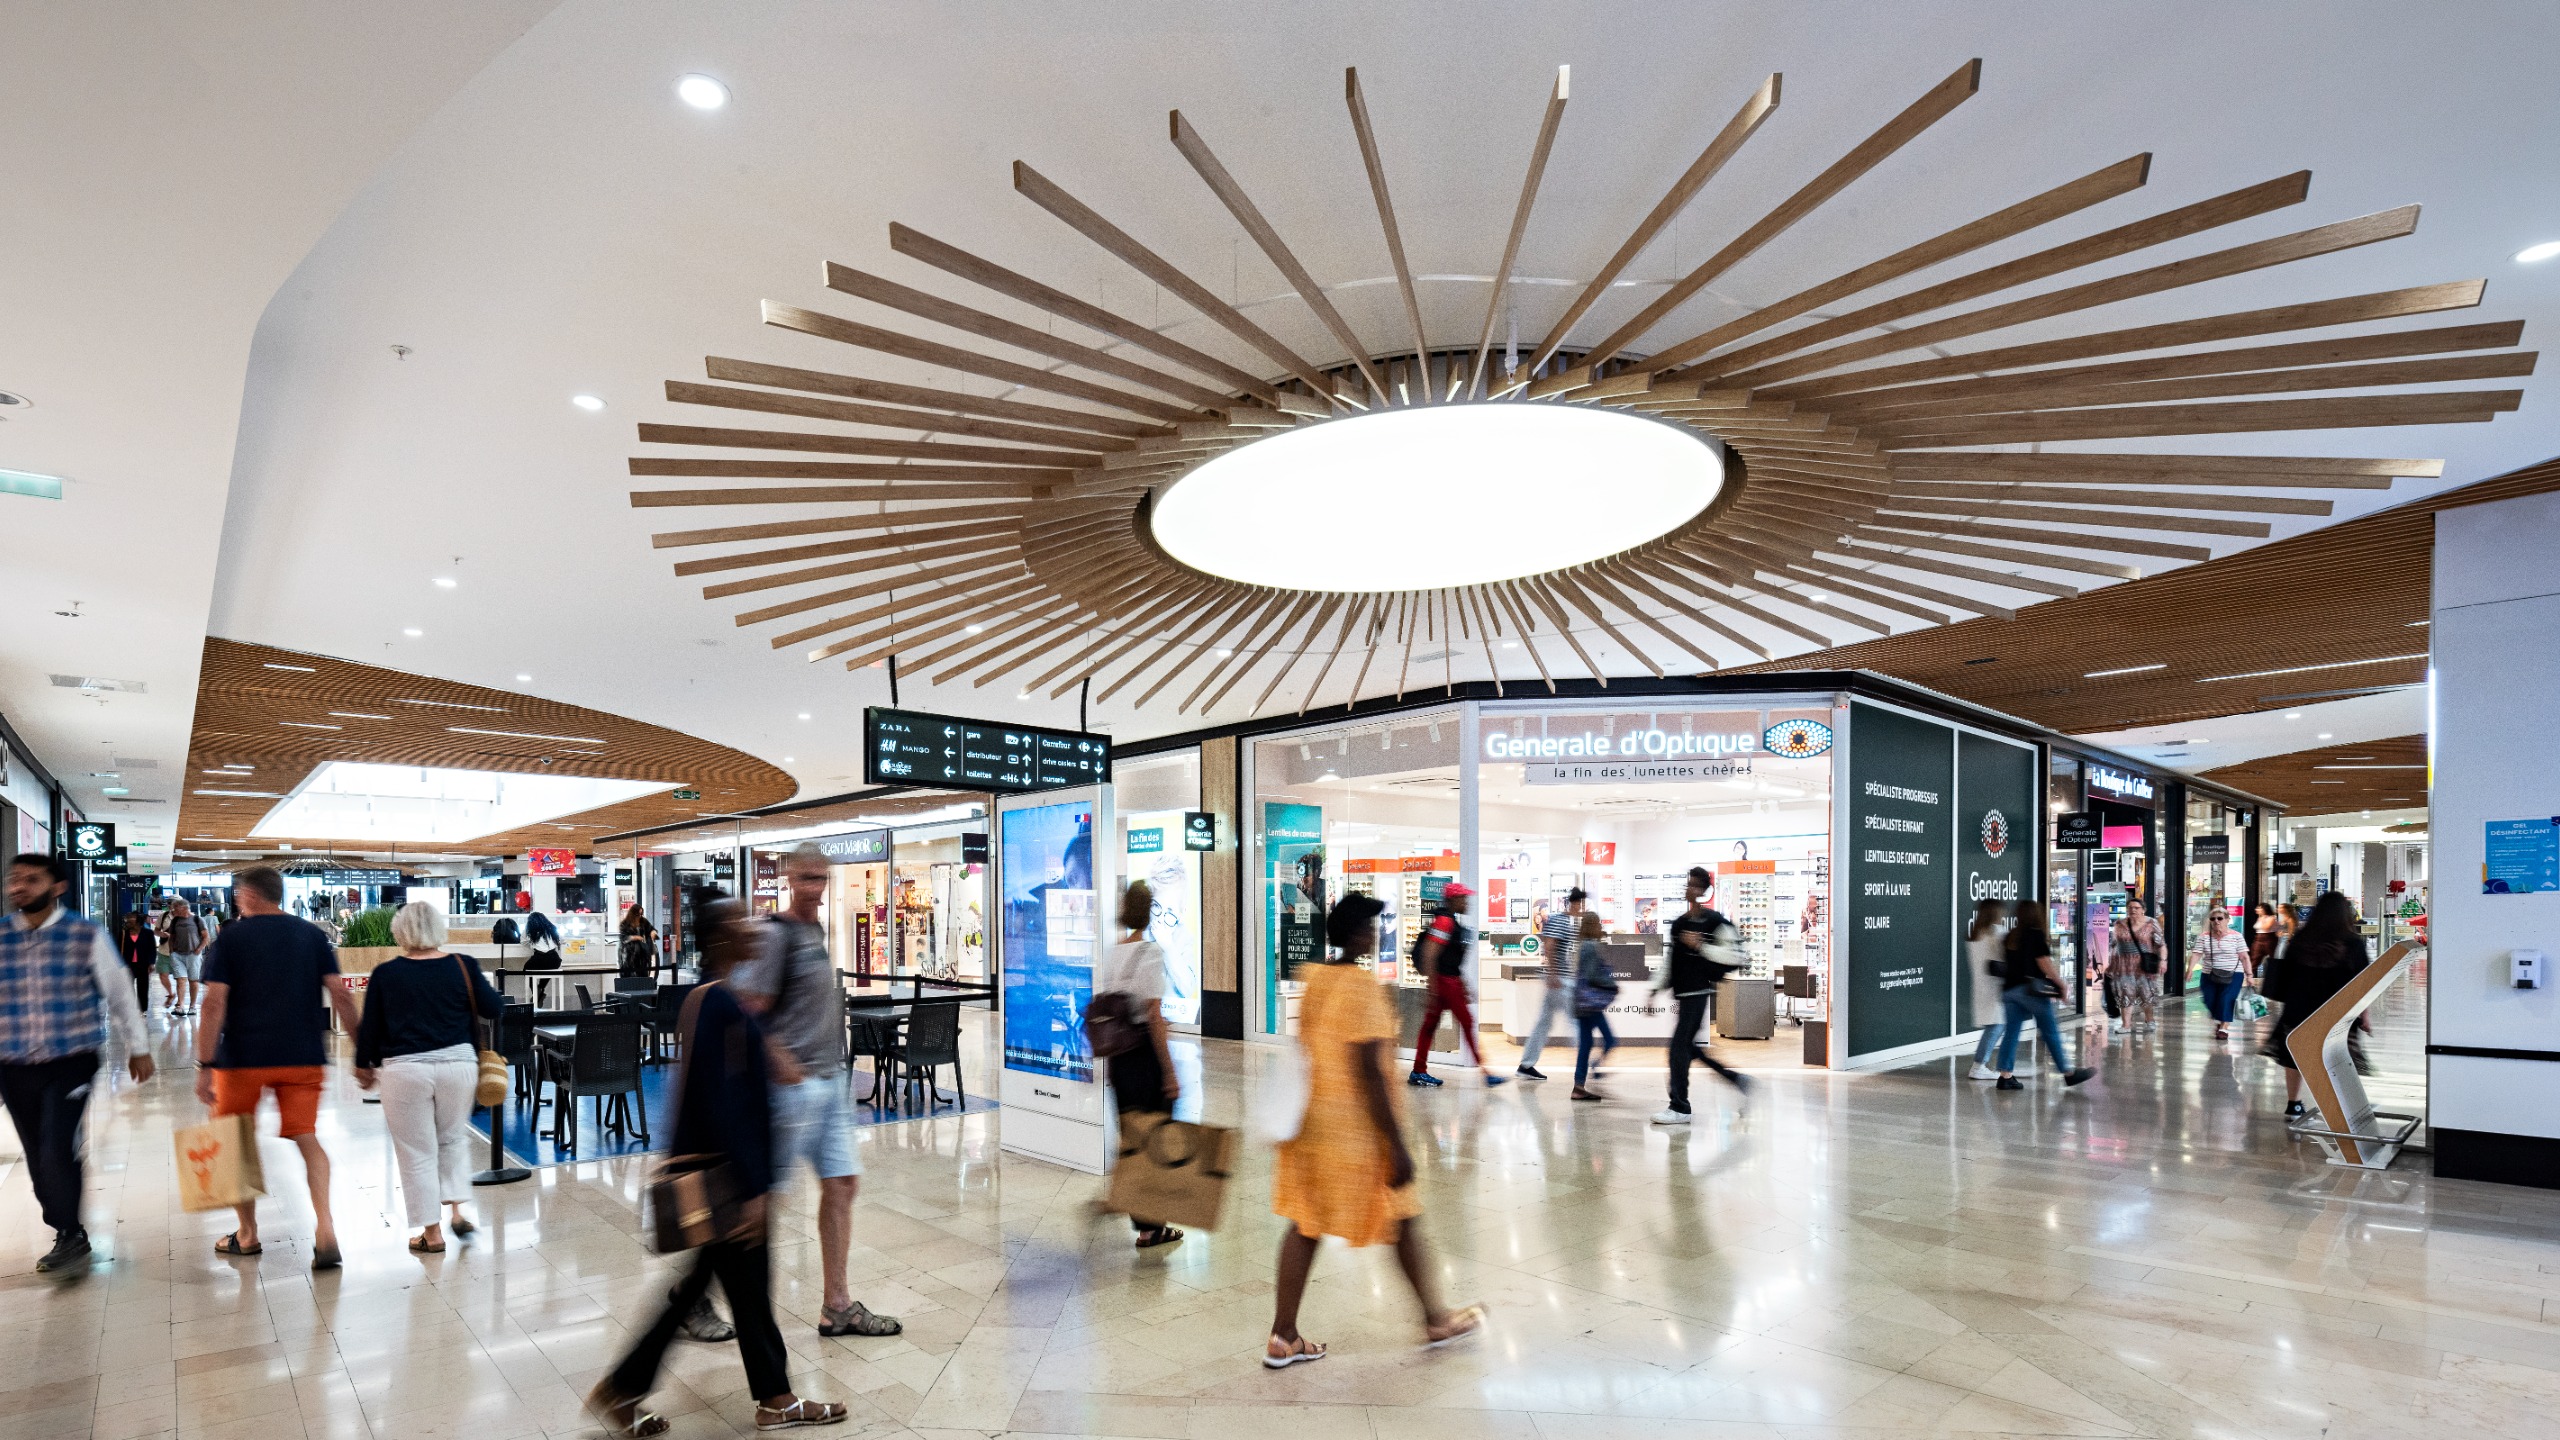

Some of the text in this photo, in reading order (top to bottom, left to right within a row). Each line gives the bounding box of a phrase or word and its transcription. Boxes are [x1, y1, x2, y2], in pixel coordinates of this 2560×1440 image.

[880, 723, 911, 733] ZARA
[966, 731, 981, 739] gare
[1042, 739, 1071, 749] Carrefour
[1487, 730, 1755, 759] Generale d'Optique
[902, 745, 930, 754] MANGO
[966, 750, 1002, 760] distributeur
[966, 770, 992, 779] toilettes
[1554, 764, 1753, 778] la fin des lunettes chères
[1865, 780, 1939, 805] SPÉCIALISTE PROGRESSIFS
[1865, 813, 1925, 834] SPÉCIALISTE ENFANT
[1130, 832, 1160, 843] La fin des
[1291, 829, 1299, 838] de
[1299, 829, 1321, 839] contact
[2061, 829, 2097, 837] Generale
[2060, 836, 2098, 844] d'Optique
[1865, 849, 1930, 866] LENTILLES DE CONTACT
[1864, 880, 1911, 896] SPORT À LA VUE
[1969, 871, 2018, 901] Generale
[1864, 916, 1890, 930] SOLAIRE
[1623, 1005, 1666, 1015] d'Optique
